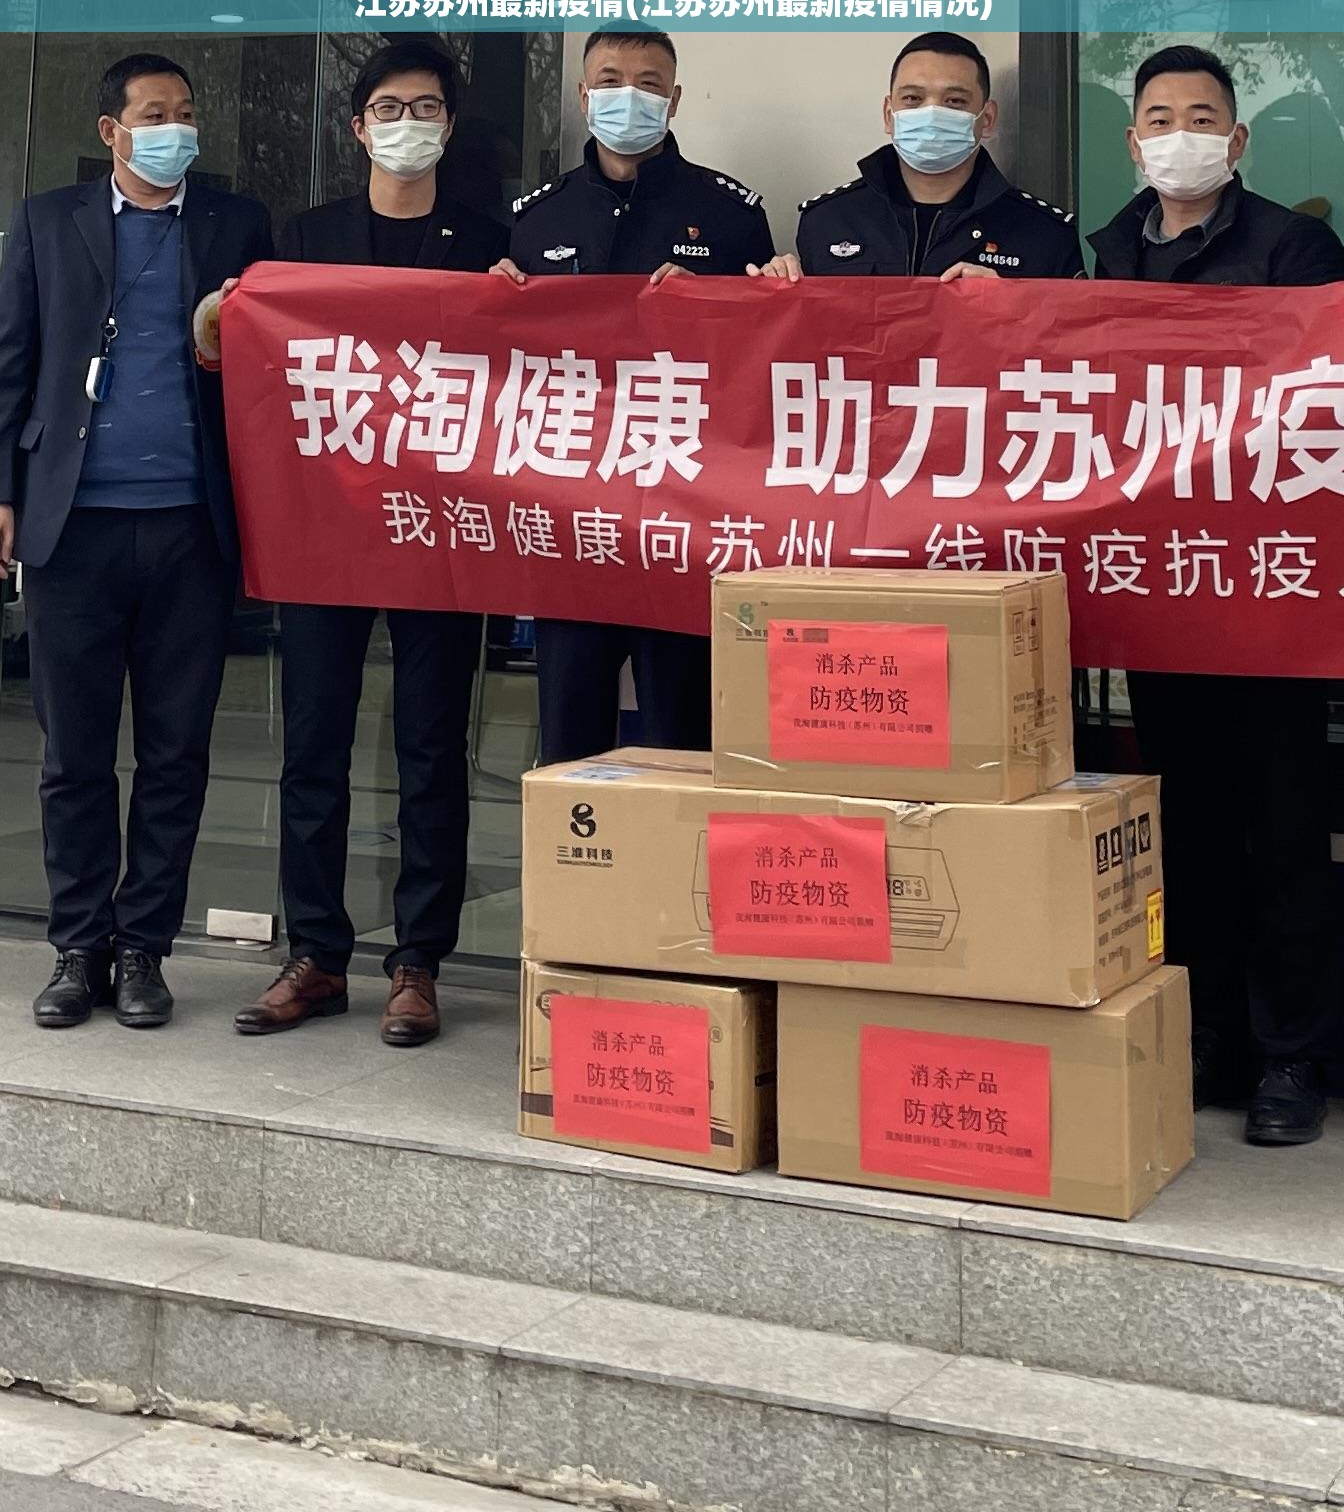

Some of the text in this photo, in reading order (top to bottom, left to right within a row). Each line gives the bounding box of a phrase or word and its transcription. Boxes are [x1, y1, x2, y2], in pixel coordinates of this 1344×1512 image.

[673, 245, 710, 256] 042223
[285, 334, 710, 488] 我淘健康
[815, 652, 898, 677] 消杀产品
[809, 685, 910, 716] 防疫物资
[754, 845, 839, 869] 消杀产品
[749, 879, 850, 909] 防疫物资
[592, 1029, 665, 1057] 消杀产品
[586, 1062, 675, 1097] 防疫物资
[910, 1063, 998, 1095] 消杀产品
[903, 1098, 1009, 1138] 防疫物资
